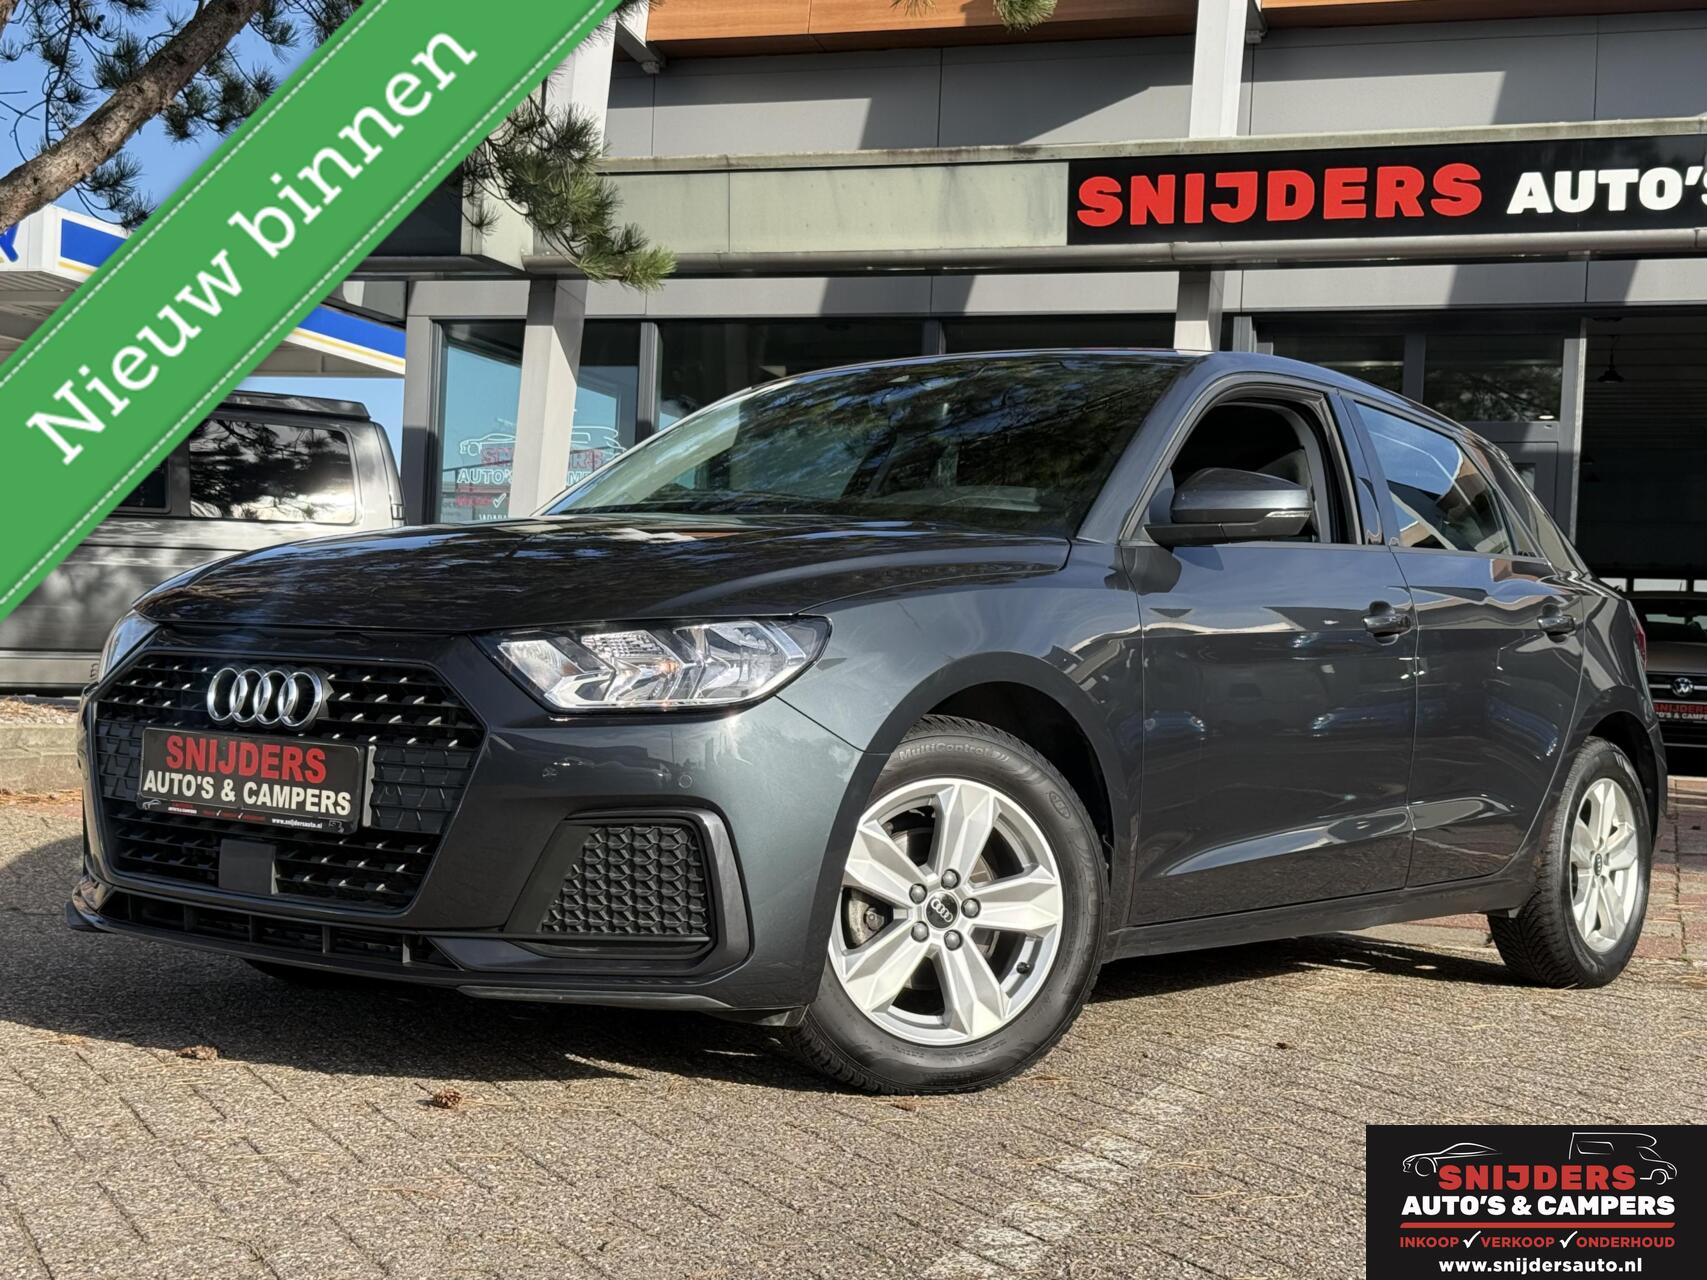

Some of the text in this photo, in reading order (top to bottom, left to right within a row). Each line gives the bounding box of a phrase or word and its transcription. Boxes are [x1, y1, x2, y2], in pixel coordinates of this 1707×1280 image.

[1076, 162, 1707, 228] SNIJDERS AUTO'
[166, 735, 326, 785] SNIJDERS
[898, 742, 989, 762] MultiControl
[143, 770, 351, 816] AUTO'S & CAMPERS
